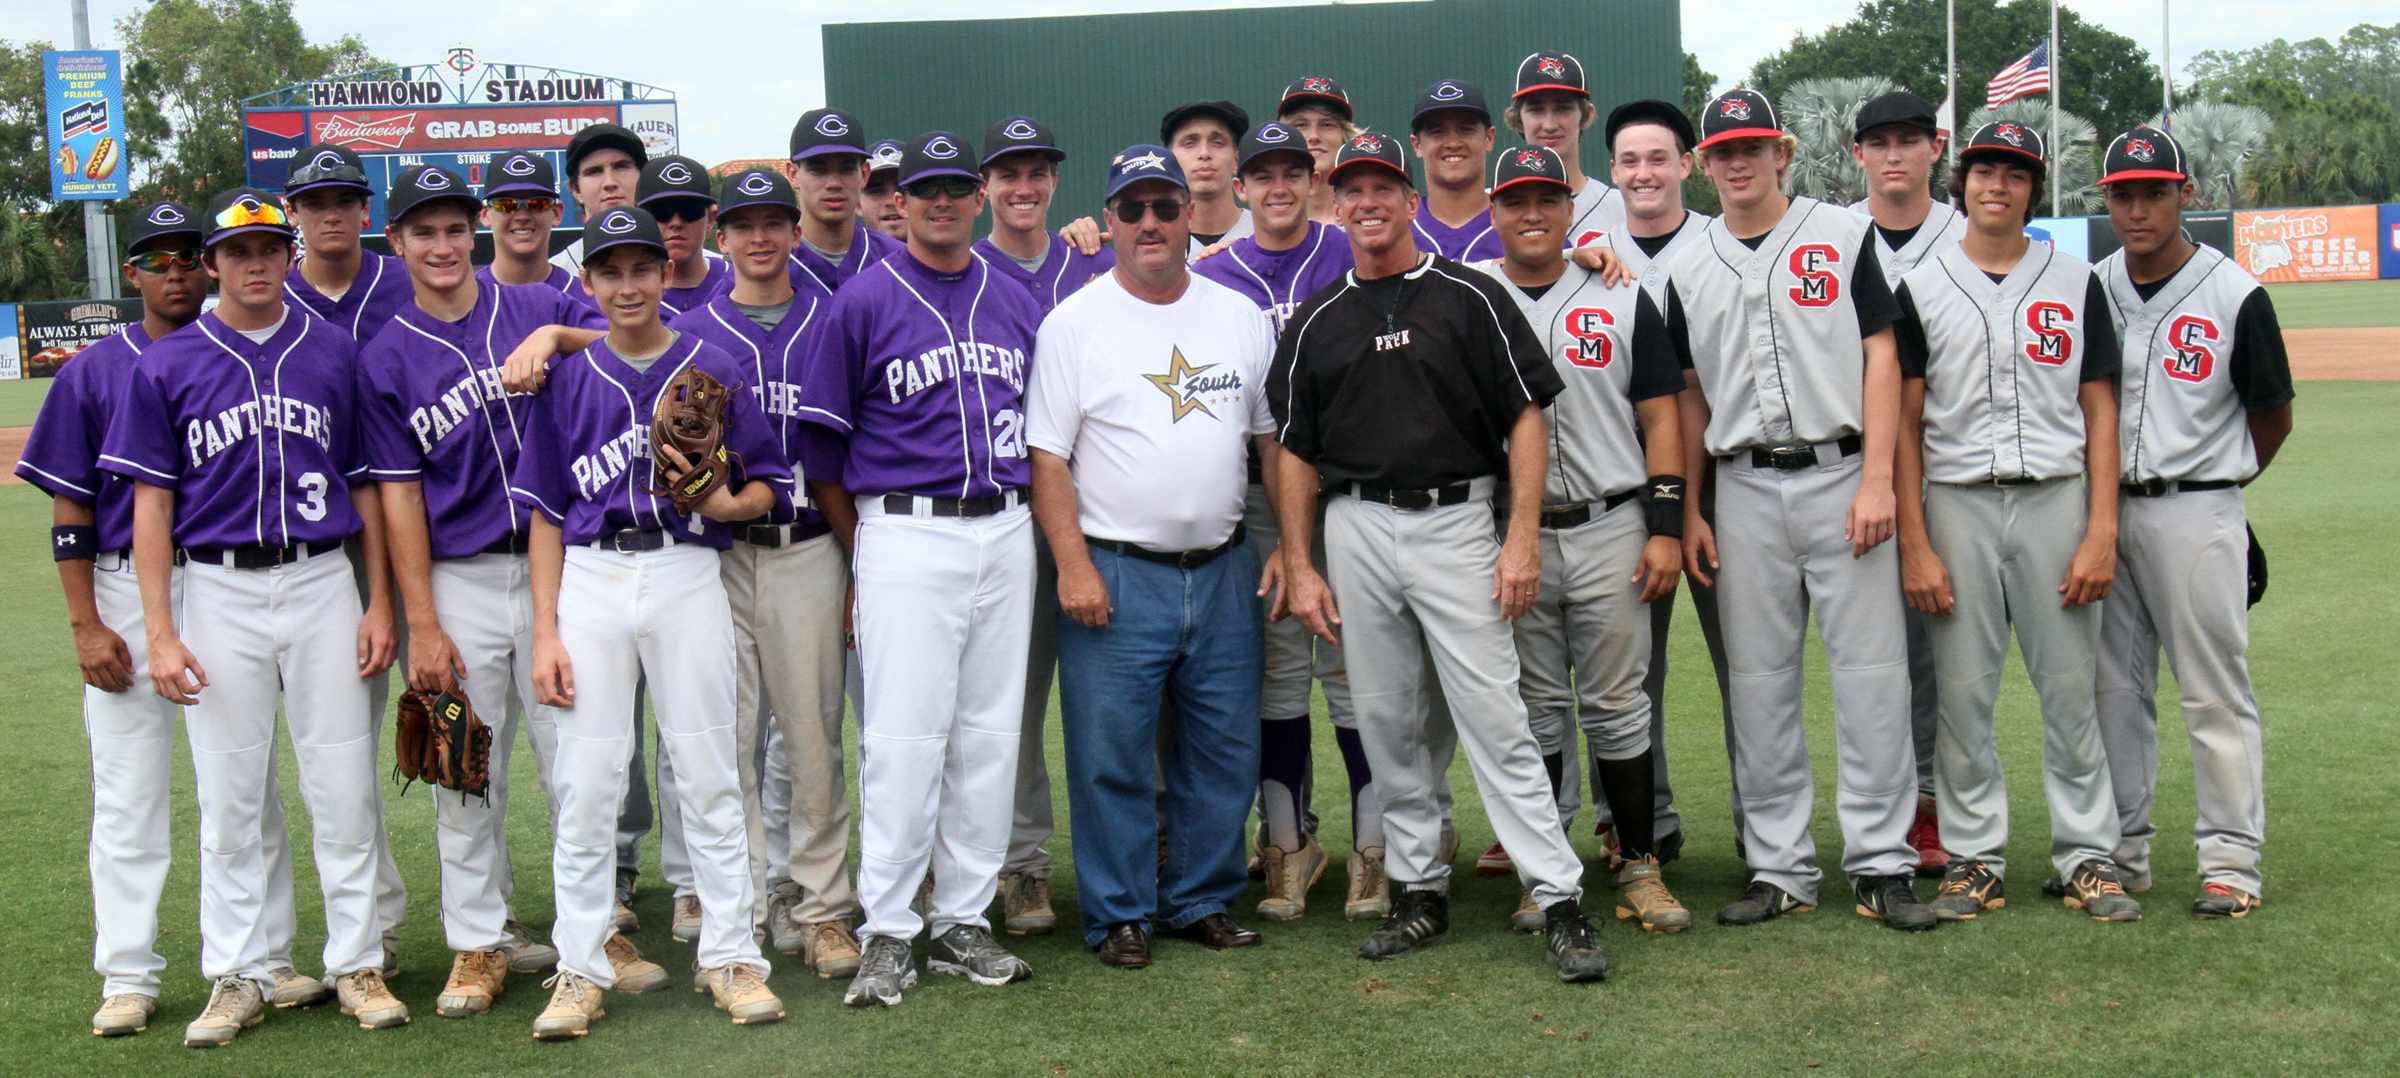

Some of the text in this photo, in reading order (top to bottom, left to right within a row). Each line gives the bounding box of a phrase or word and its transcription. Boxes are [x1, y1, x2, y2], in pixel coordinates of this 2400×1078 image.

[58, 72, 107, 80] PREMIUM
[64, 90, 103, 98] FRANKS
[312, 77, 605, 106] HAMMOND STADIUM
[65, 107, 104, 125] National Deli
[315, 121, 416, 142] Budweiser
[425, 120, 497, 140] GRAB
[497, 123, 543, 135] SOME
[399, 153, 492, 166] BALL STRIKE
[71, 303, 118, 322] GRIMALDI'S
[29, 325, 77, 339] ALWAYS
[80, 325, 88, 337] A
[41, 340, 56, 349] Bell
[57, 339, 80, 349] Tower
[886, 341, 1025, 405] PANTHERS
[1182, 369, 1243, 401] South
[410, 362, 550, 455] PANTH
[187, 394, 332, 469] PANTHERS
[571, 424, 654, 503] PANTH
[296, 472, 329, 522] 3
